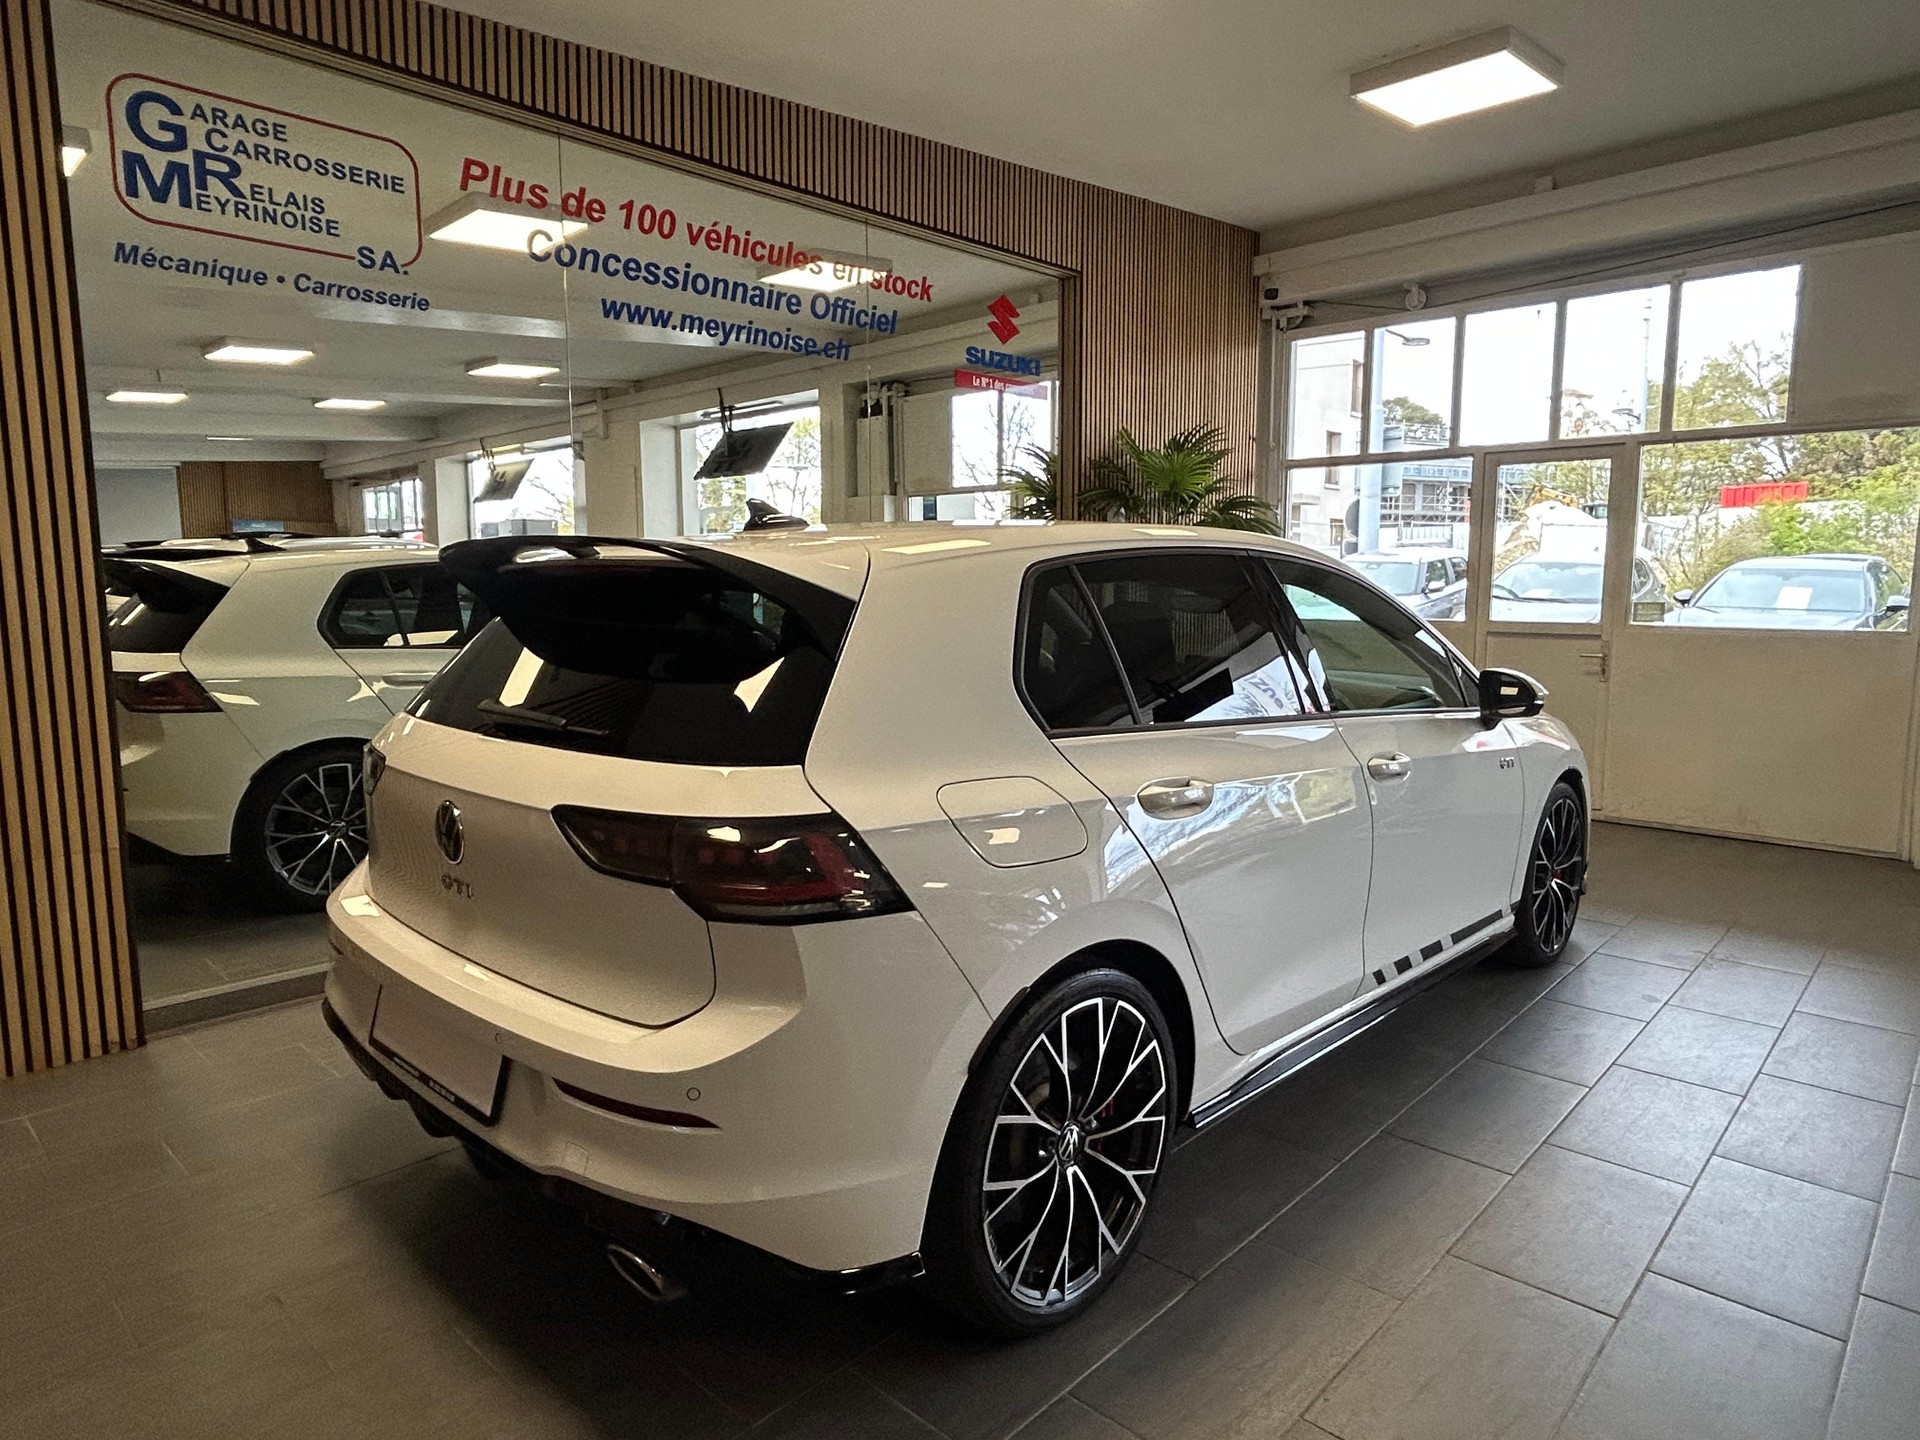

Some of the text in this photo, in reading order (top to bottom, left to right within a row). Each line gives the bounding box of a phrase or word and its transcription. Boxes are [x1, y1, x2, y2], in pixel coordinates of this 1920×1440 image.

[204, 127, 405, 194] CARROSSERIE
[459, 157, 549, 210] Plus
[561, 186, 607, 223] de
[619, 199, 677, 240] 100
[686, 221, 824, 276] véhicules
[869, 265, 934, 303] stock
[113, 242, 430, 312] Mécanique Carrosserie
[527, 228, 899, 336] Concessionnaire Officiel
[601, 298, 851, 362] www.meyrinoise.ch
[965, 346, 1041, 376] SUZUKI
[440, 873, 475, 900] GTI
